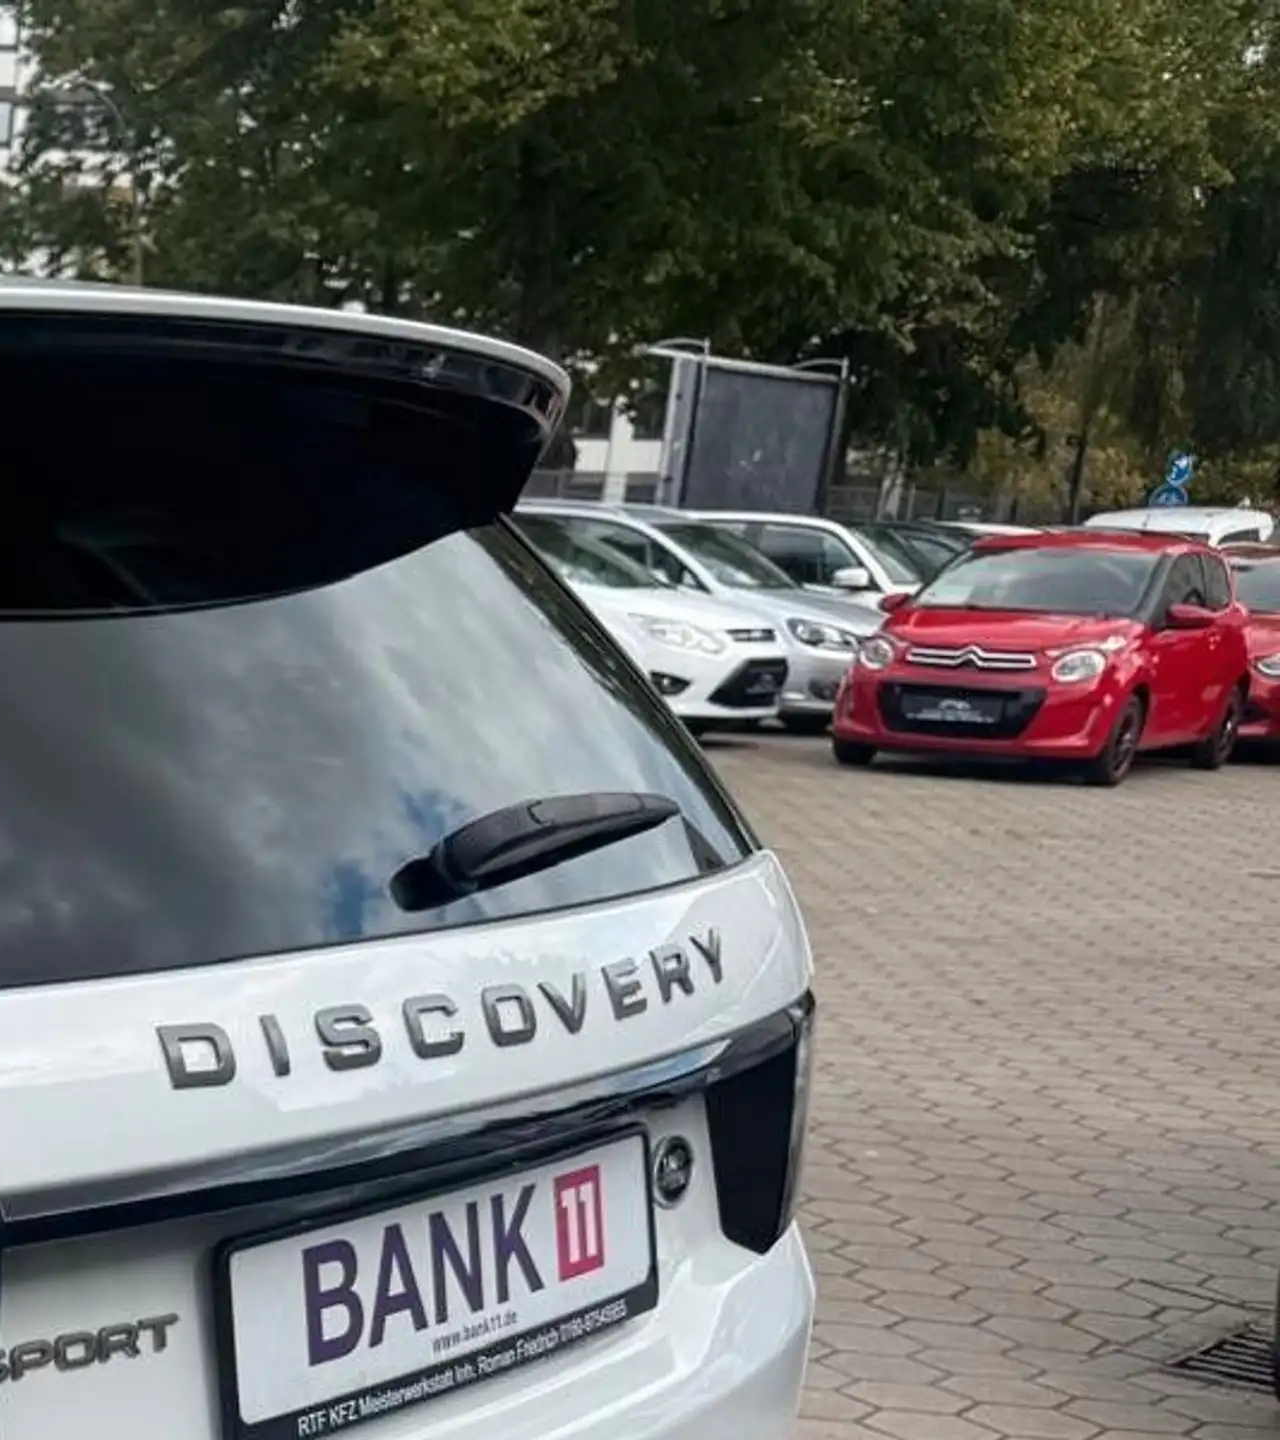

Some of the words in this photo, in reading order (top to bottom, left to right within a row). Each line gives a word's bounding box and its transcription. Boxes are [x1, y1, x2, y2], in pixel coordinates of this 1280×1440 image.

[155, 927, 724, 1089] DISCOVERY
[301, 1183, 545, 1368] BANK
[561, 1181, 598, 1264] 11
[433, 1309, 517, 1353] www.bank11.de
[297, 1409, 328, 1438] RTF
[329, 1401, 357, 1428] KFZ
[358, 1370, 454, 1416] Meisterwerkstatt
[516, 1327, 559, 1362] Friedrich
